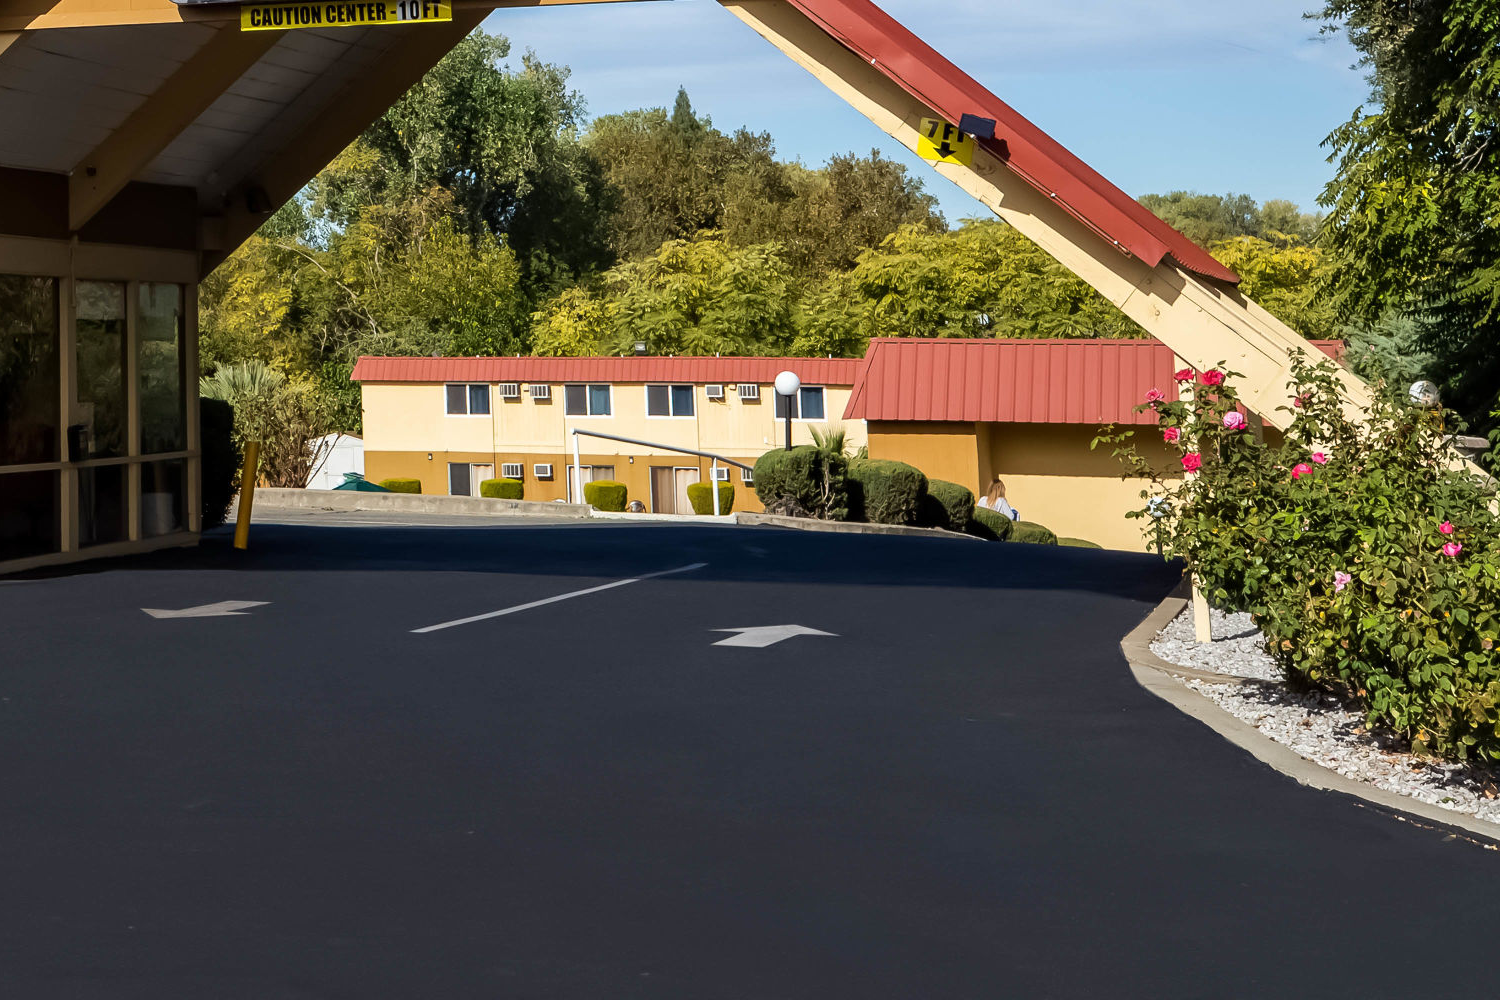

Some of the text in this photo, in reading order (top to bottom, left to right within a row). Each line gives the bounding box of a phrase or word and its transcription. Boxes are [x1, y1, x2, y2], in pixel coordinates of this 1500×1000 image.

[250, 3, 324, 27] CAUTION
[325, 2, 387, 24] CENTER
[422, 0, 442, 18] FT
[927, 120, 939, 138] 7
